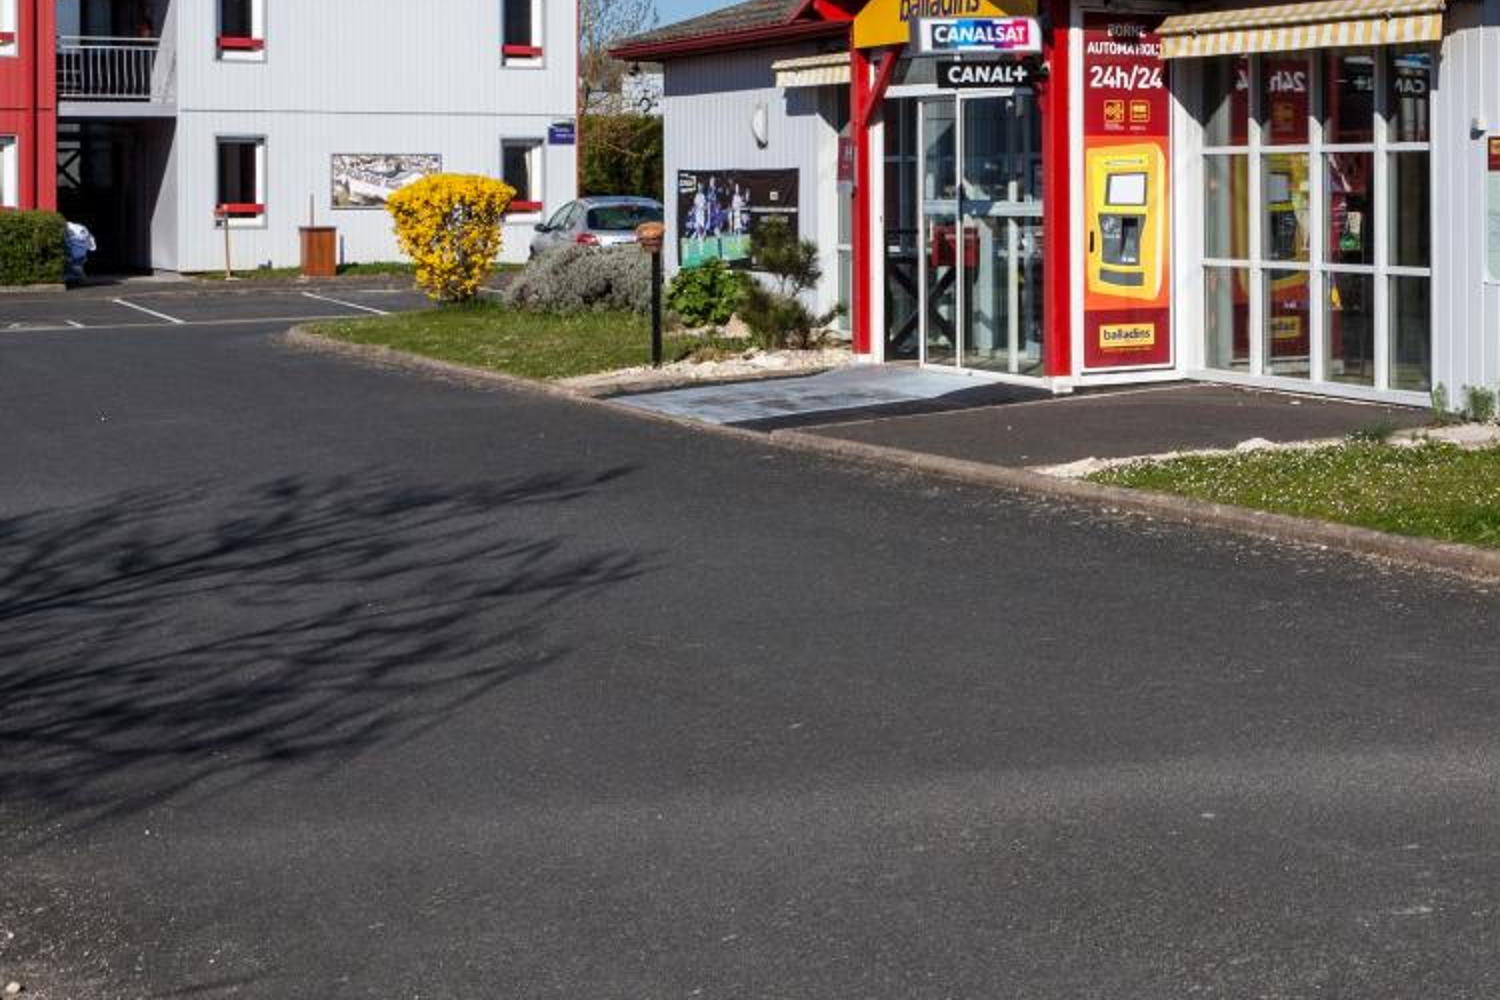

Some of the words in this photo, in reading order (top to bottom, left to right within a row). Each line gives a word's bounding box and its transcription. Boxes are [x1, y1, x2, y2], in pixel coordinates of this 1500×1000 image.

[934, 26, 1025, 43] CANALSAT
[1088, 42, 1160, 56] AUTOMATIQU
[948, 65, 1027, 83] CANAL+
[1090, 65, 1163, 90] 24h/24
[1103, 327, 1151, 340] balladins
